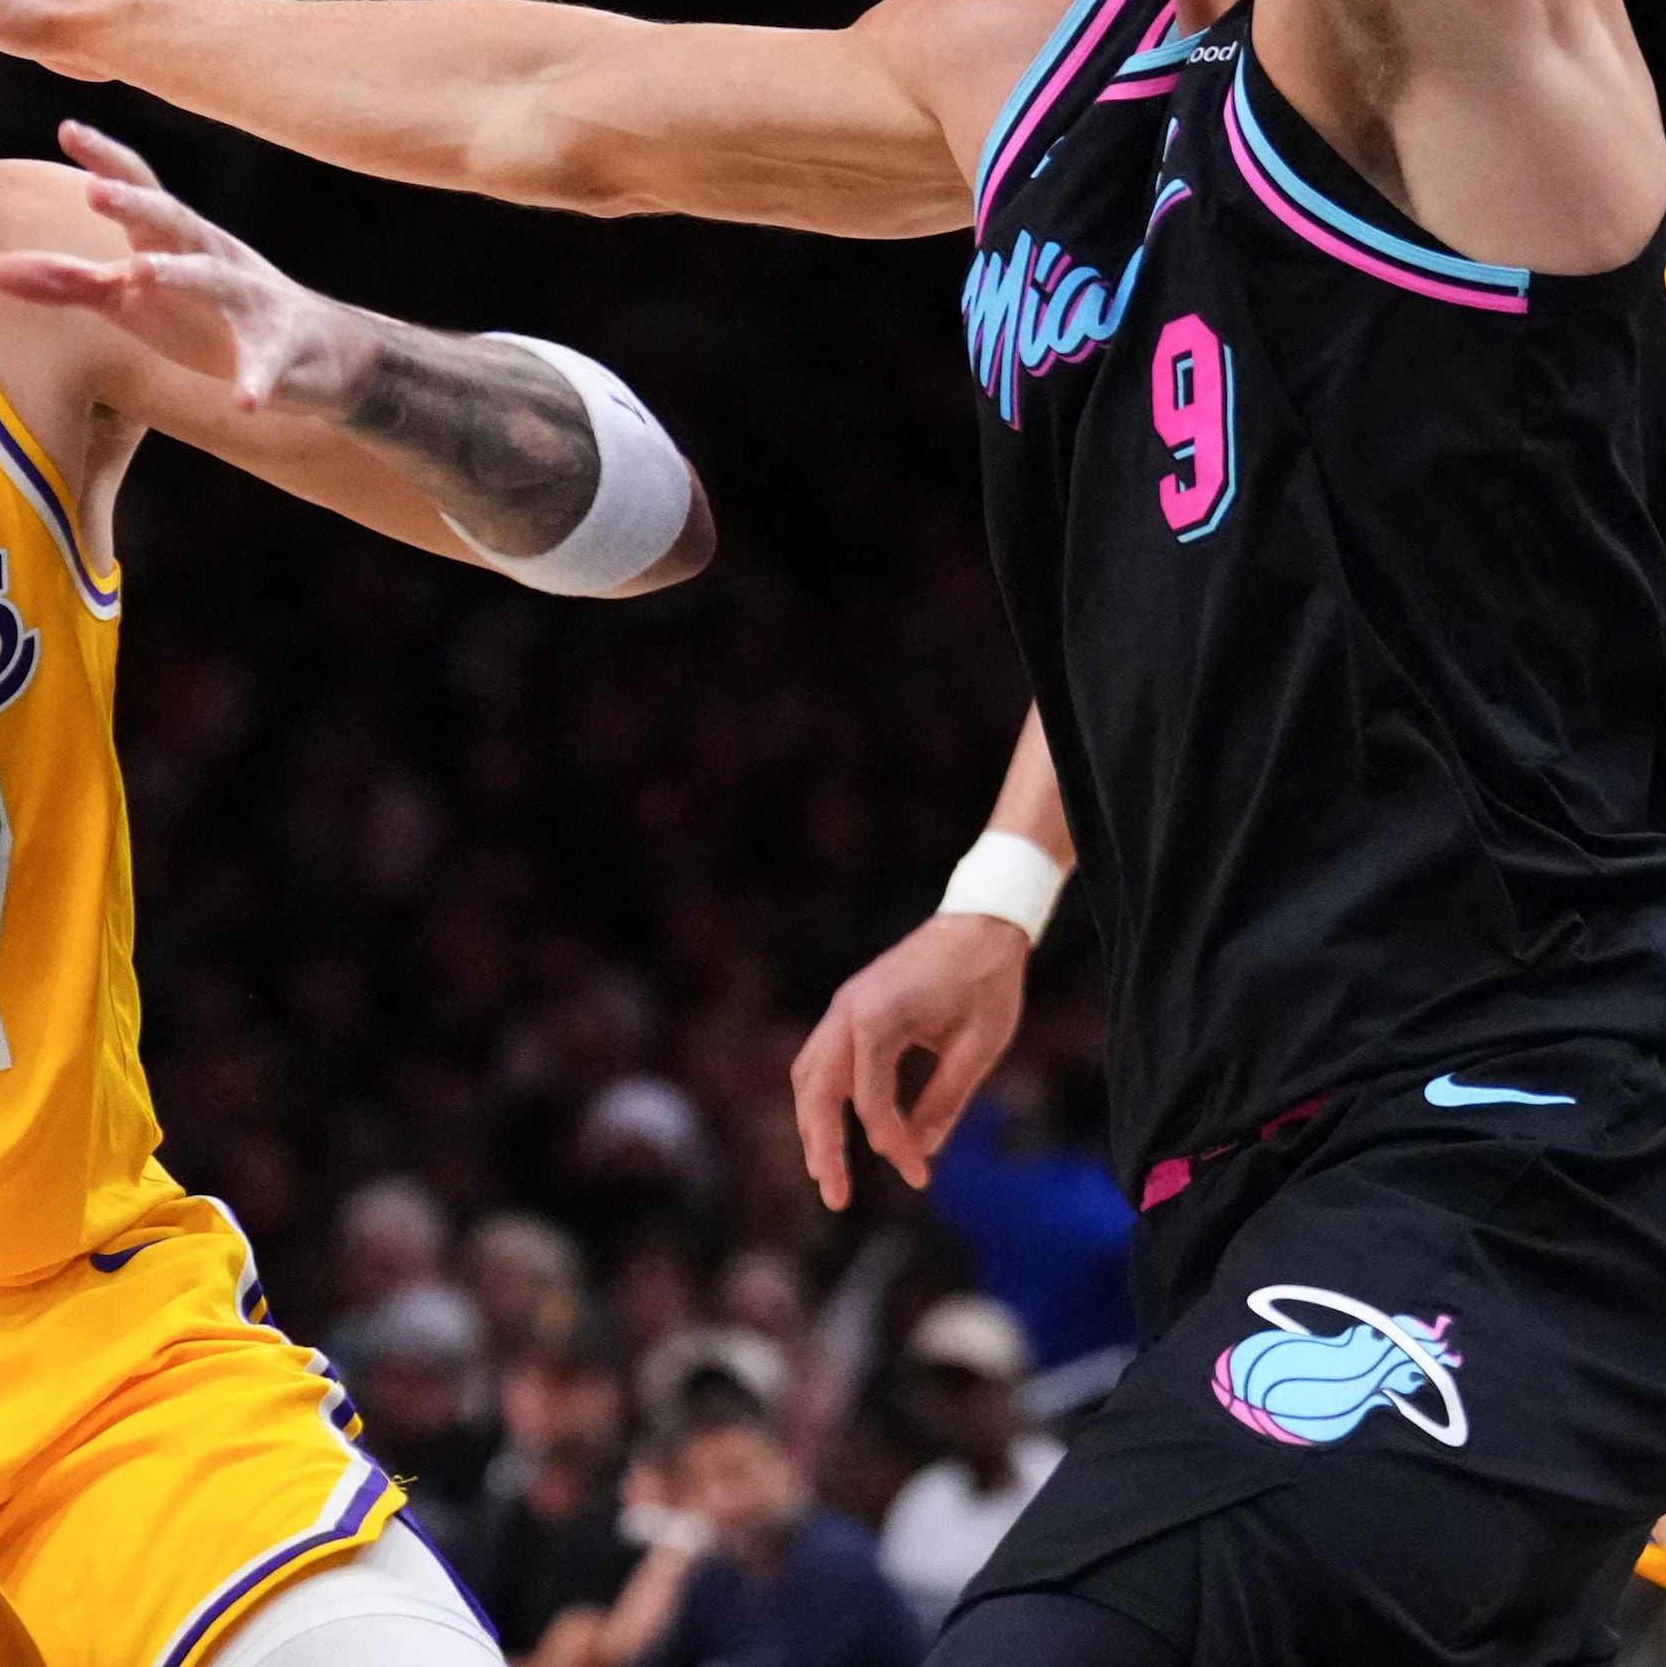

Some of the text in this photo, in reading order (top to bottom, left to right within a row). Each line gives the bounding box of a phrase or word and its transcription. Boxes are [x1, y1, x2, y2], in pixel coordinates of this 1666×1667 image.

[1186, 40, 1238, 64] ood
[961, 177, 1191, 432] Mia
[1152, 314, 1236, 543] 9
